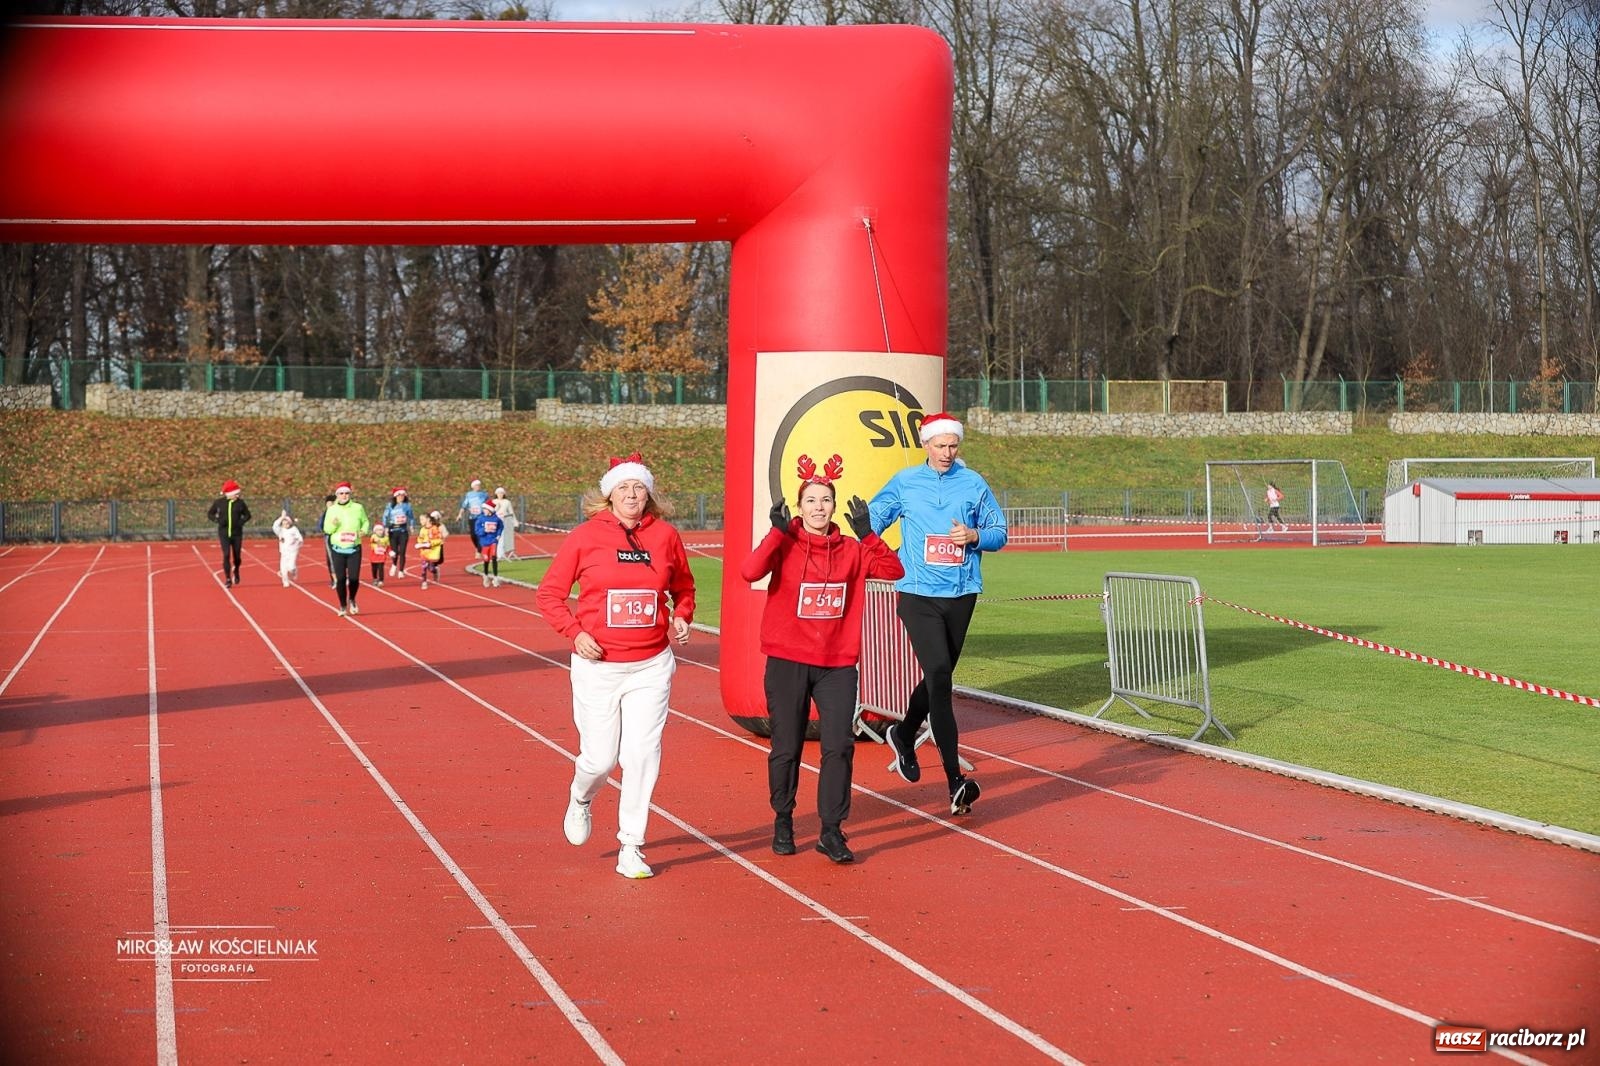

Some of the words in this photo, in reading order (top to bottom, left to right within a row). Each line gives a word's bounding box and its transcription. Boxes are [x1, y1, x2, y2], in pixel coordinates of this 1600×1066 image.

[937, 542, 955, 555] 60
[815, 594, 831, 607] 51
[625, 601, 643, 615] 13
